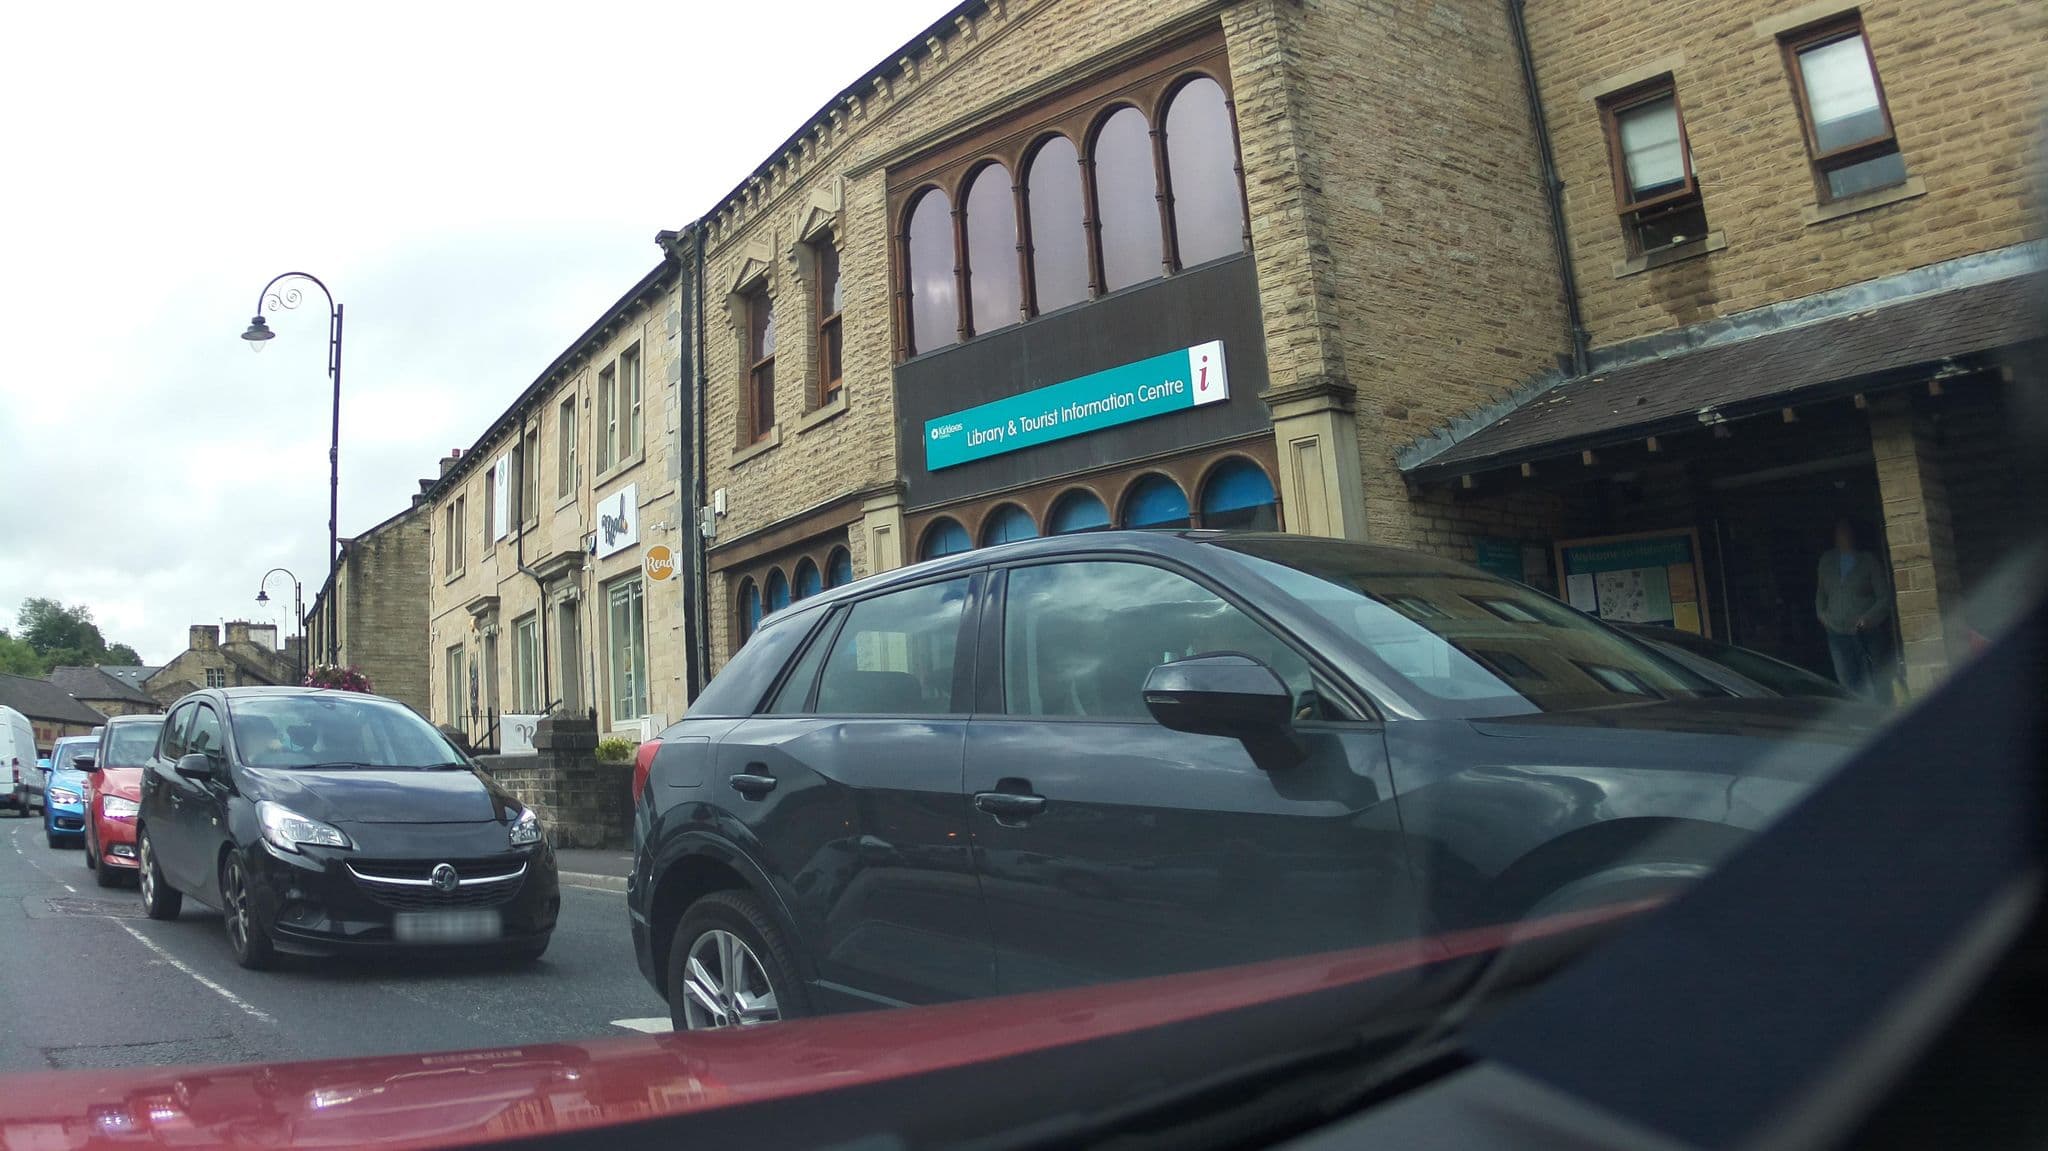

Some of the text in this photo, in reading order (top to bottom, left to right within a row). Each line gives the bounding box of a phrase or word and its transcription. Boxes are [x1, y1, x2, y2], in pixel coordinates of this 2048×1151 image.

[967, 378, 1184, 447] Library & Tourist Information Centre
[646, 553, 675, 573] Read
